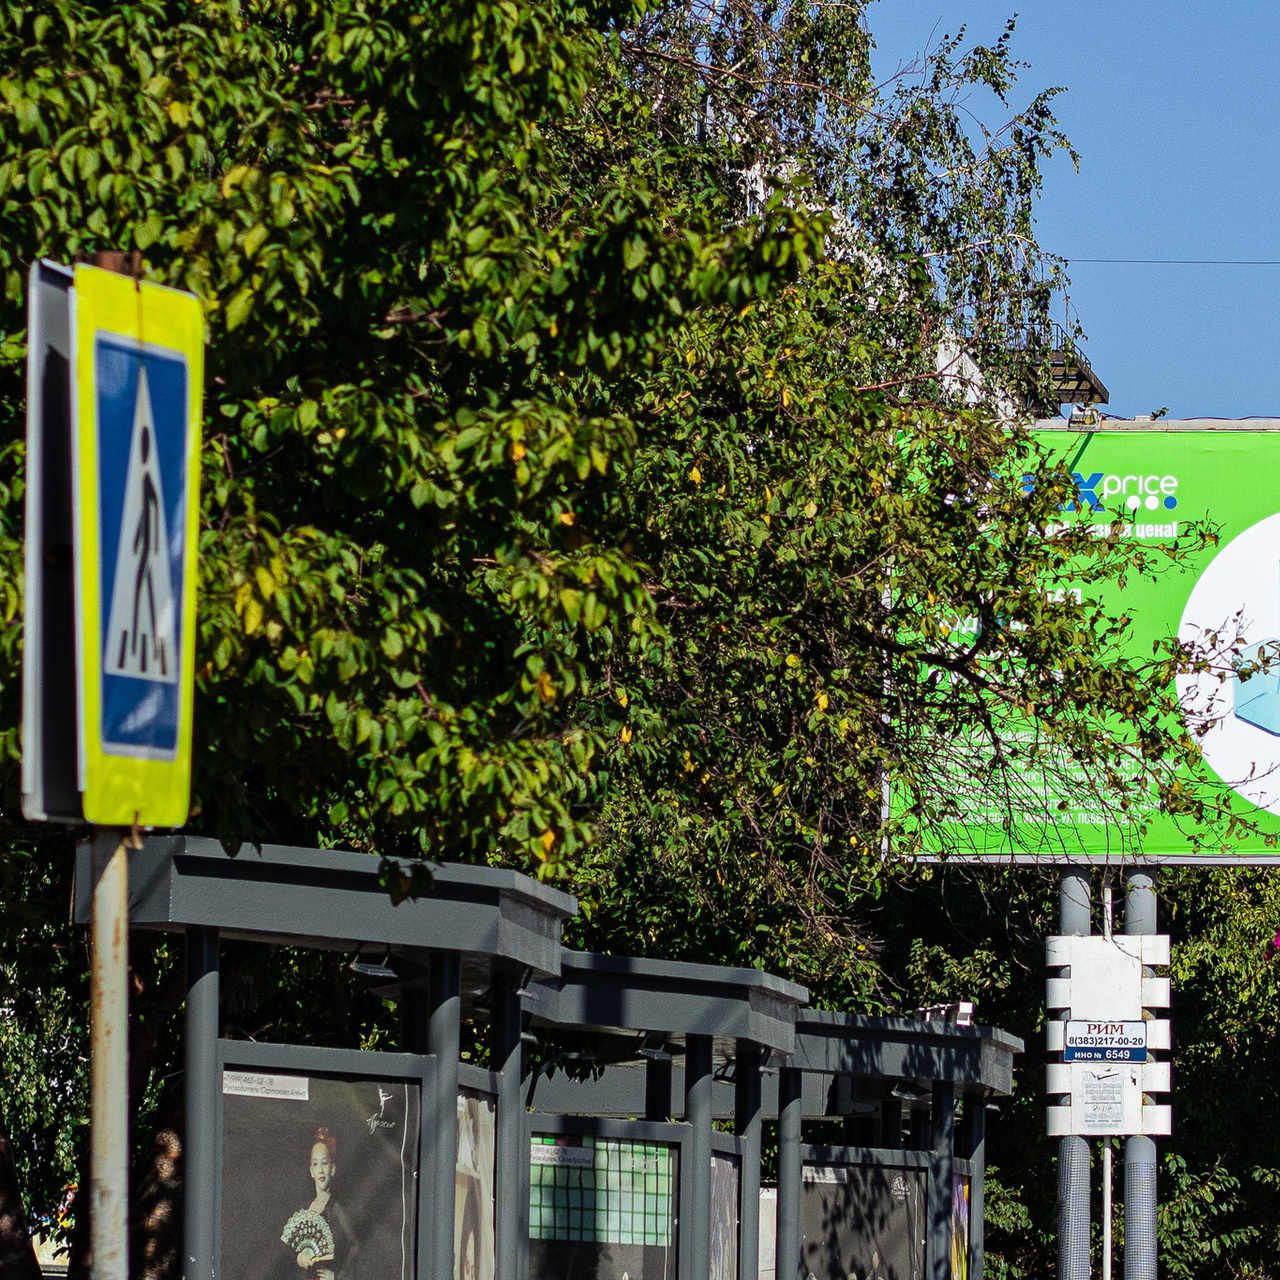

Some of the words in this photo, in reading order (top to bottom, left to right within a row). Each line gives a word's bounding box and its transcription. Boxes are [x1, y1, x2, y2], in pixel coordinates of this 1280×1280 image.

[1103, 475, 1178, 500] price
[1135, 522, 1178, 538] цена!
[1087, 1024, 1124, 1035] РИМ
[1068, 1036, 1143, 1046] 8(383)217-00-20
[1106, 1050, 1130, 1059] 6549
